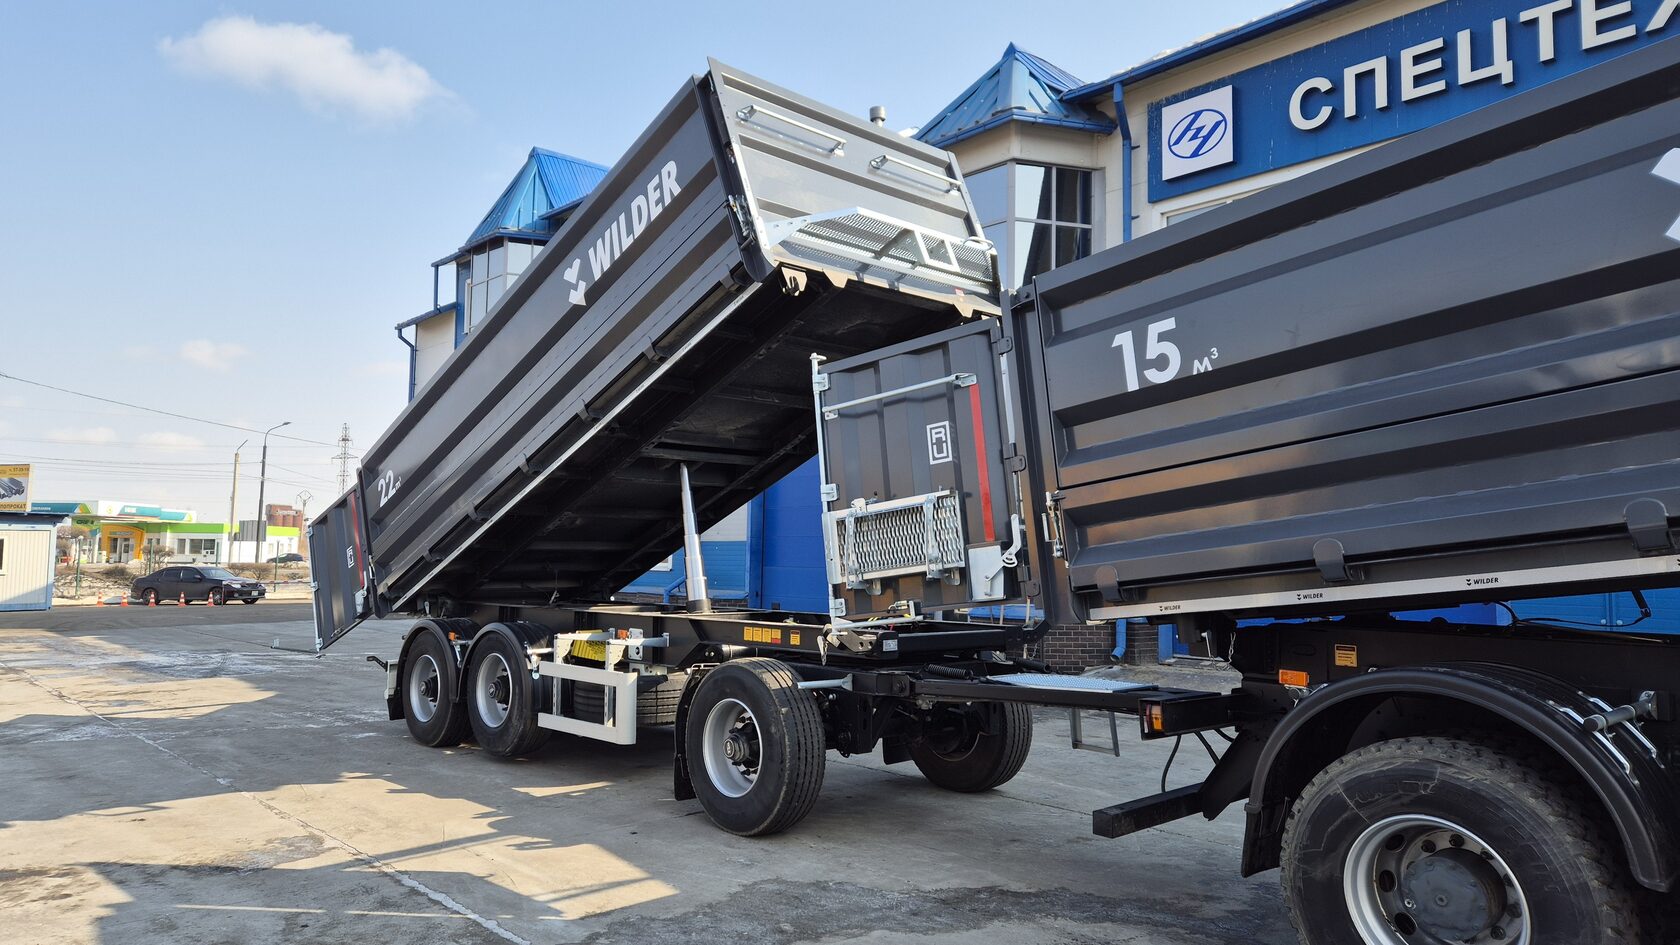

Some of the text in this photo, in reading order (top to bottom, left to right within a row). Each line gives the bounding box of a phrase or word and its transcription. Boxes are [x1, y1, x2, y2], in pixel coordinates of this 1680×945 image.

[588, 160, 682, 281] WILDER
[1111, 316, 1182, 392] 15
[378, 470, 397, 508] 22
[1302, 592, 1323, 600] WILDER
[1473, 577, 1499, 585] WILDER
